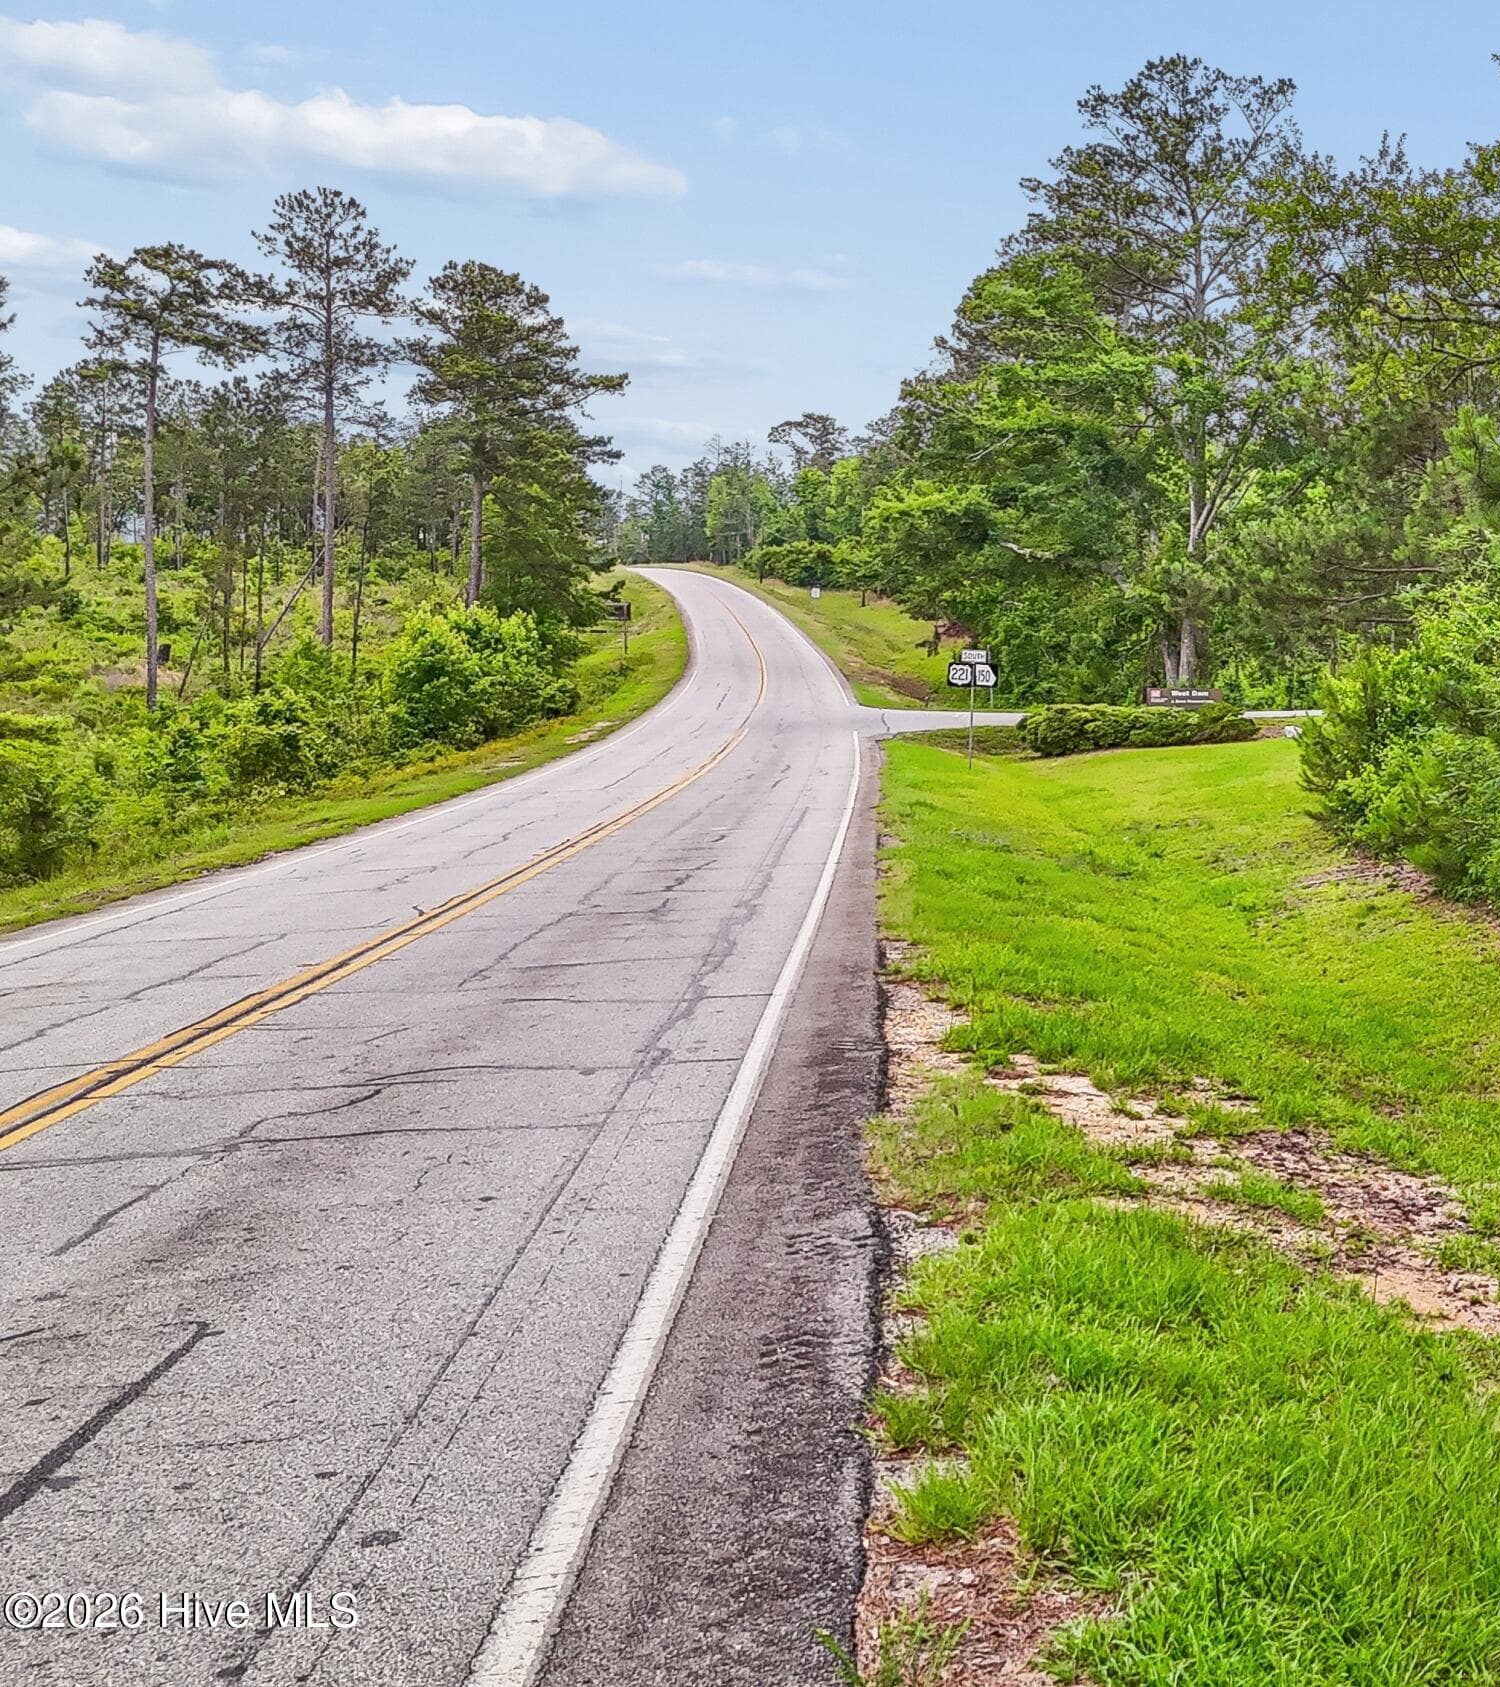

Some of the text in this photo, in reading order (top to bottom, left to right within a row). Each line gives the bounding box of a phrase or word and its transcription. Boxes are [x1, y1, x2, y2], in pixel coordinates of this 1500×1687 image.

[963, 652, 985, 660] SOUTH
[951, 667, 968, 680] 221
[978, 669, 990, 682] 150
